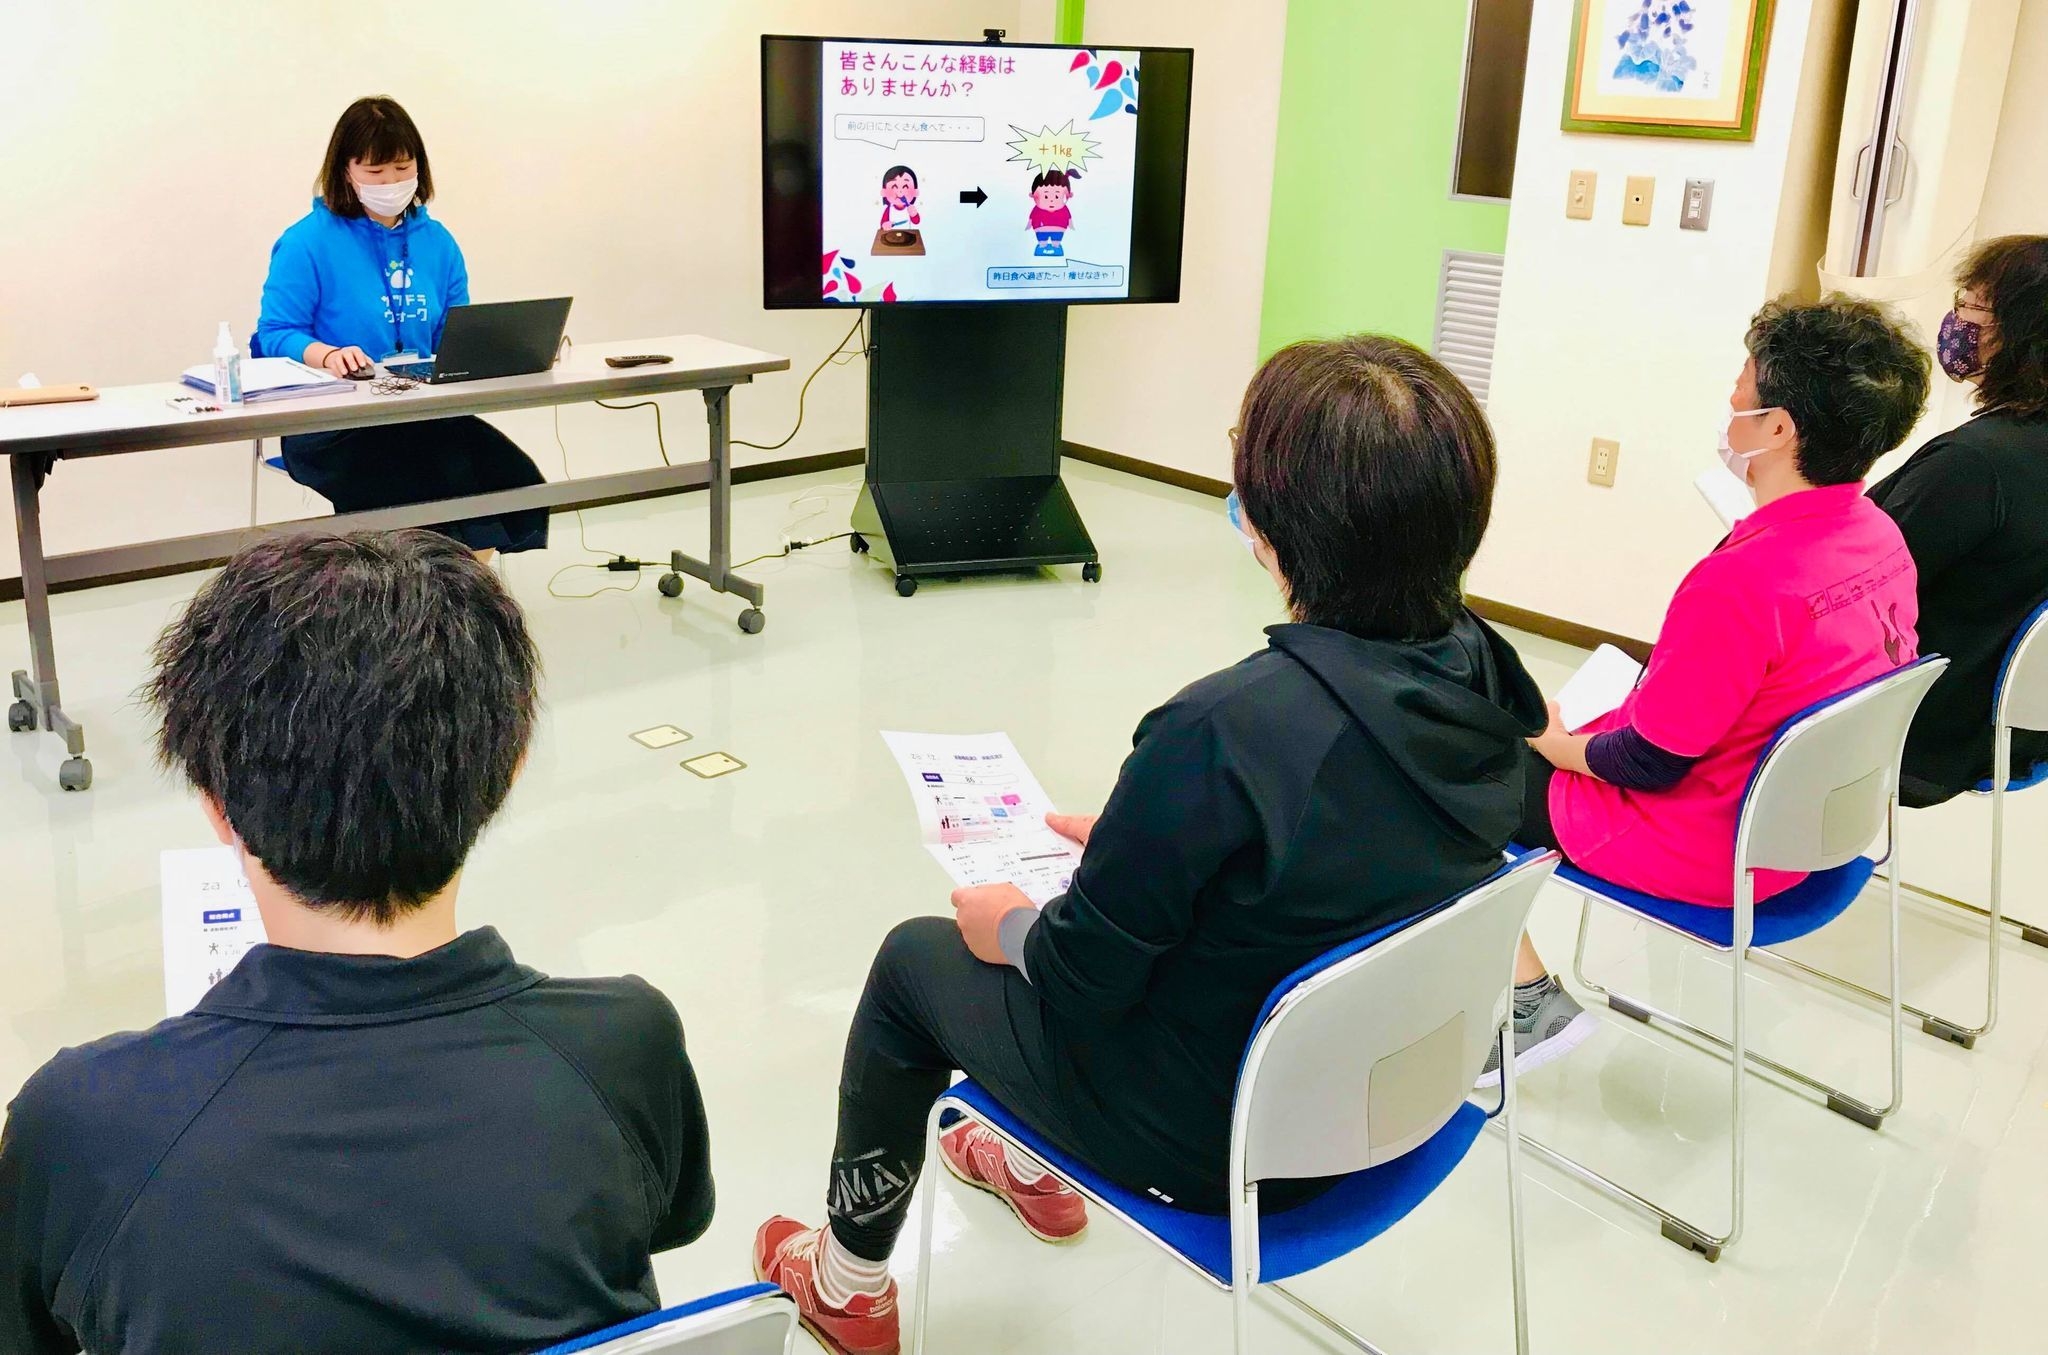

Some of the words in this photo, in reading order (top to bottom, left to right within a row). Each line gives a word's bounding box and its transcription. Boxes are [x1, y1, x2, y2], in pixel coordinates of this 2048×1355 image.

[839, 50, 1016, 75] 皆さんこんな経験は
[839, 76, 974, 98] ありませんか？
